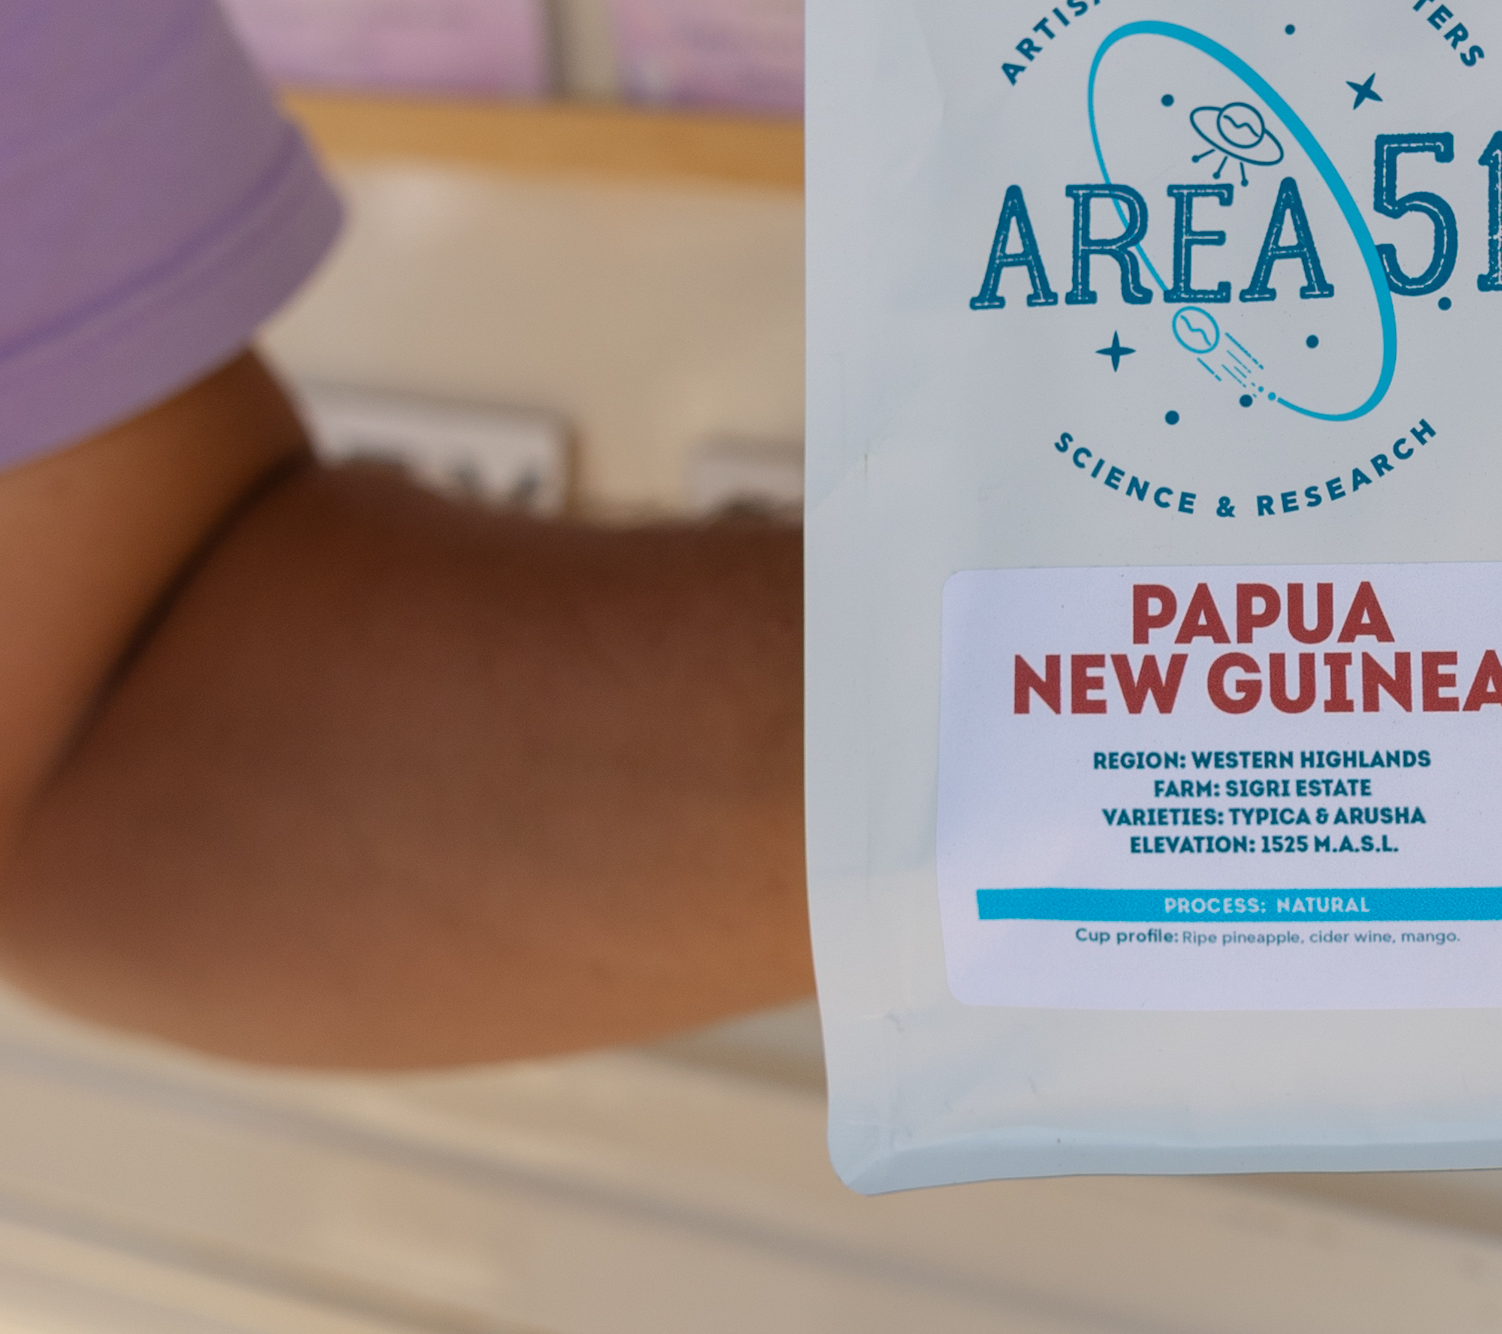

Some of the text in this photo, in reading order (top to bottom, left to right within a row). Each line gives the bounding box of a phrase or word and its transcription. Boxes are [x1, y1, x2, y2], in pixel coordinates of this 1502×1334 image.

[969, 177, 1335, 311] AREA
[1053, 418, 1436, 518] SCIENCE & RESEARCH
[1132, 581, 1395, 645] PAPUA
[1013, 653, 1189, 715] NEW
[1093, 750, 1432, 770] REGION: WESTERN HIGHLANDS
[1154, 778, 1372, 798] FARM: SIGRI ESTATE
[1102, 806, 1427, 827] VARIETIES: TYPICA & ARUSHA
[1130, 835, 1399, 854] ELEVATION: 1525 M.A.S.L.
[1164, 896, 1371, 914] PROCESS: NATURAL
[1075, 927, 1462, 946] Cup profile: Ripe pineapple, cider wine, mango.
